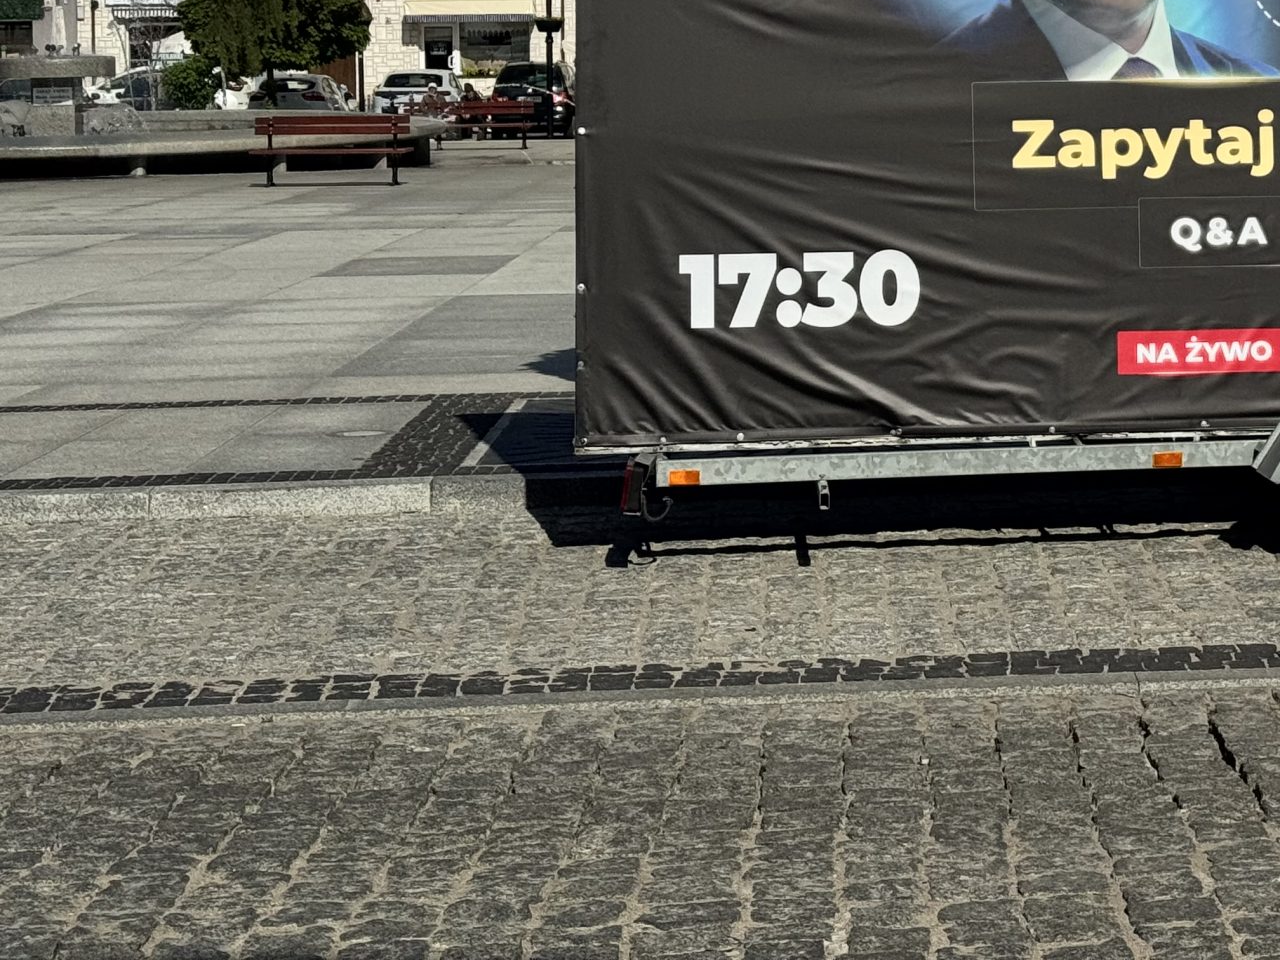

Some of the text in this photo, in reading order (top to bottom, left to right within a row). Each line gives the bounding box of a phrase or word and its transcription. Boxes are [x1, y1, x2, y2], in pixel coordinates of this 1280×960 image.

[1011, 108, 1276, 180] Zapytaj
[1170, 216, 1268, 253] Q&A
[678, 249, 921, 329] 17:30
[1136, 335, 1273, 364] NA ŻYWO
